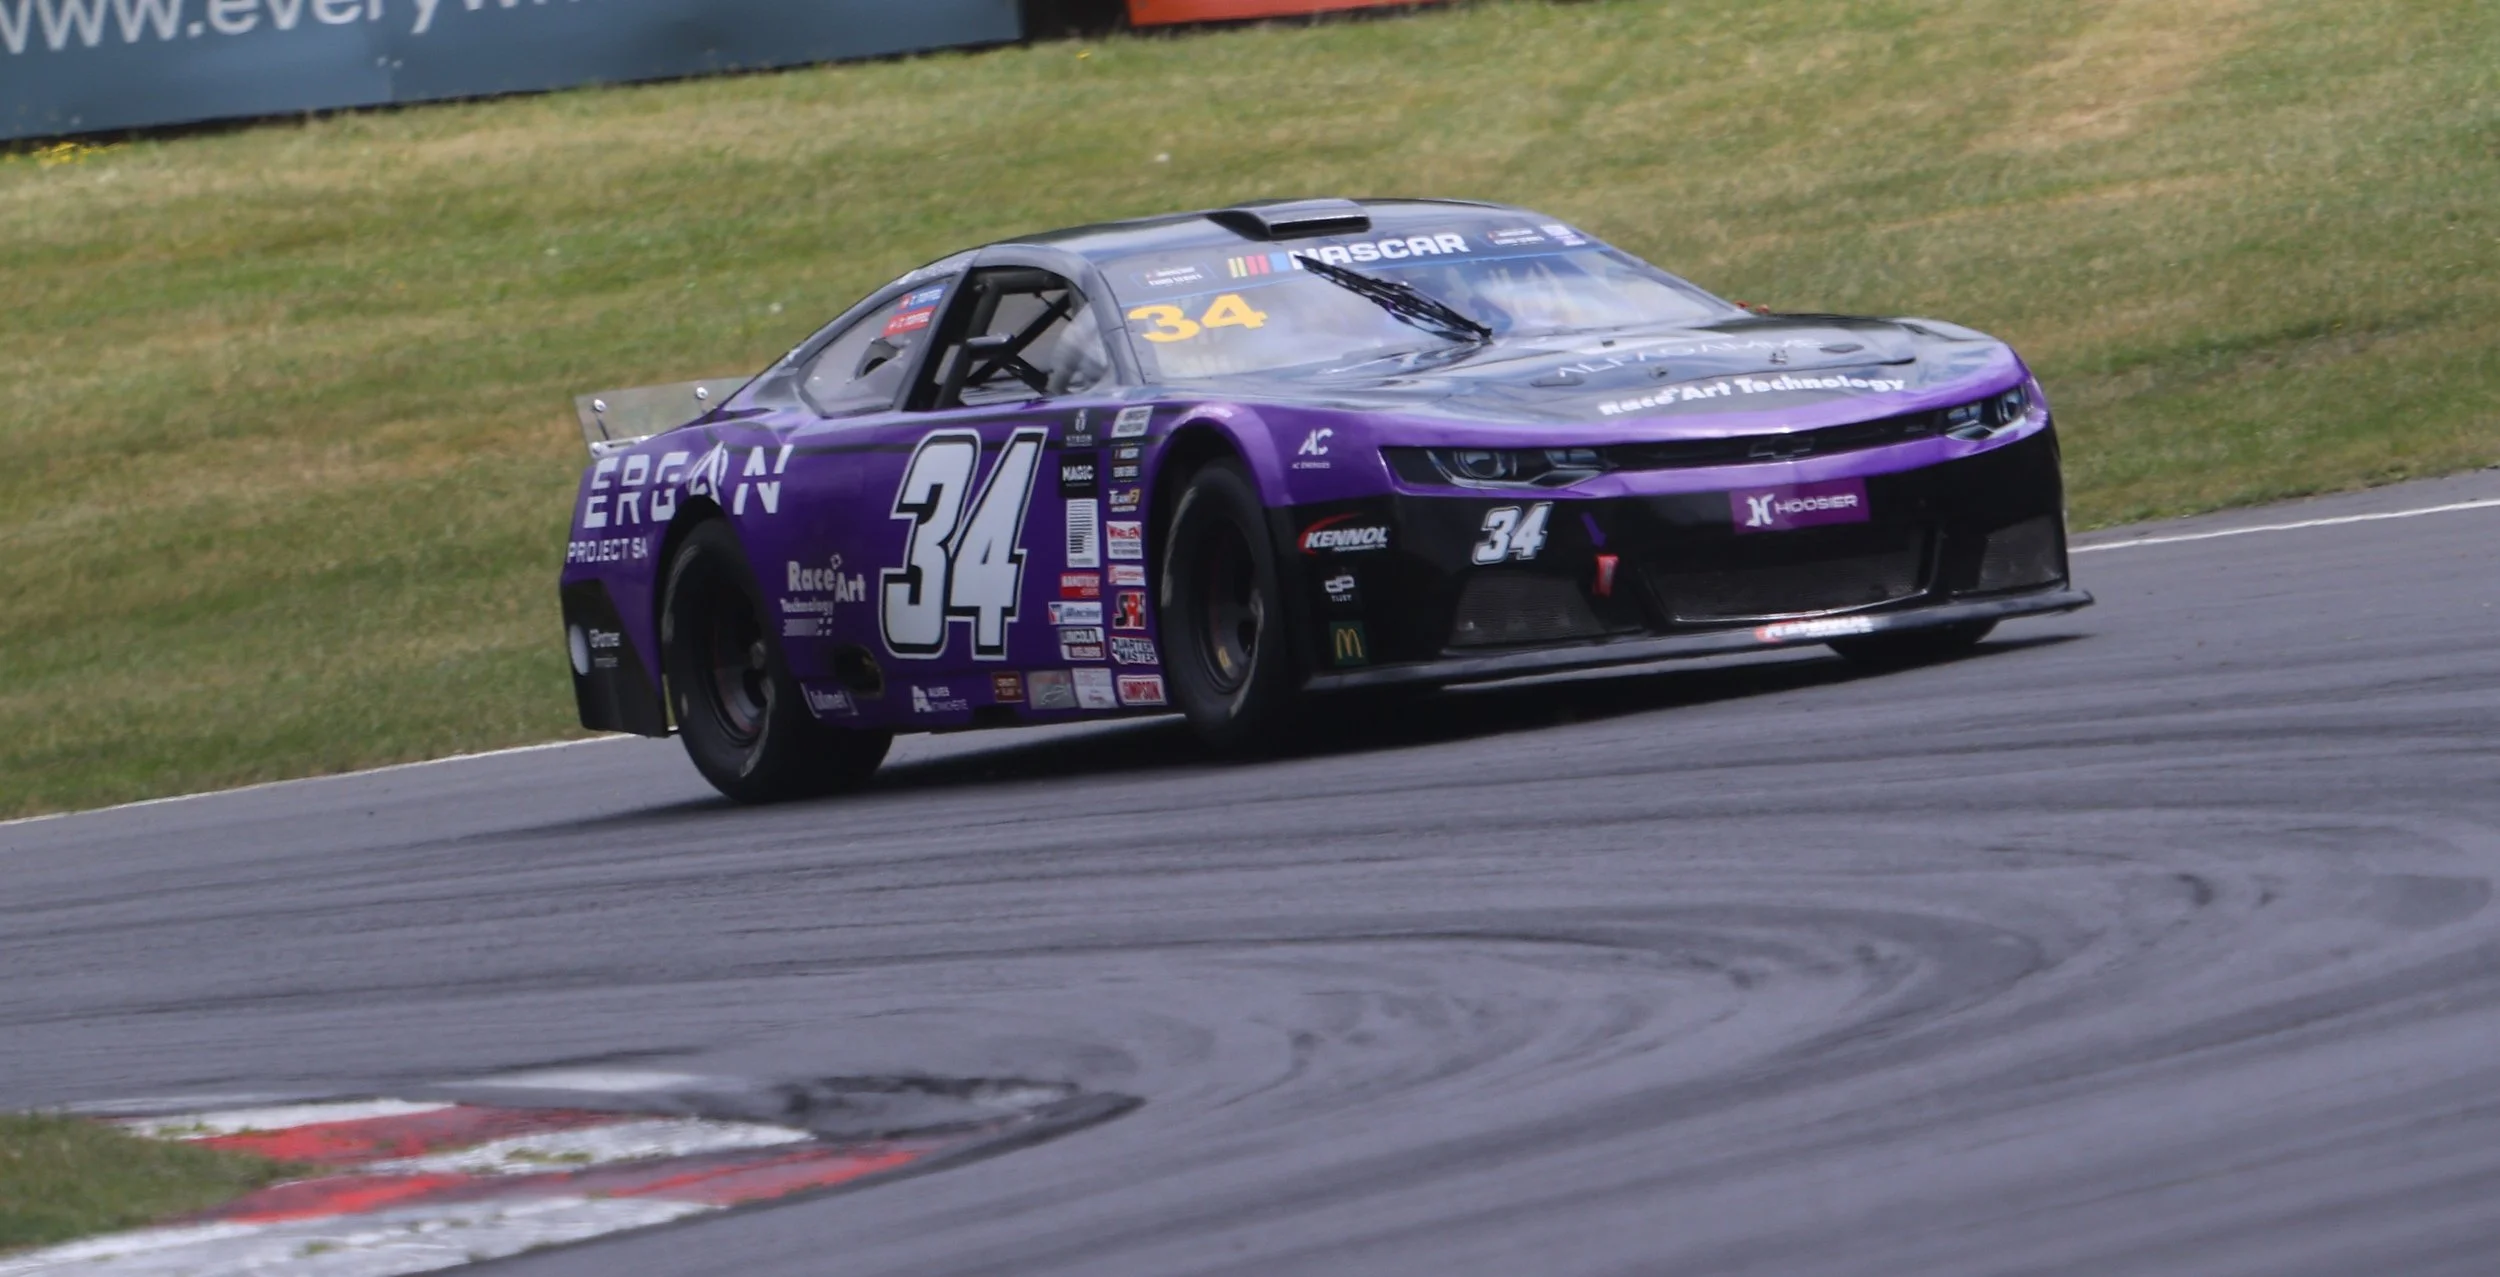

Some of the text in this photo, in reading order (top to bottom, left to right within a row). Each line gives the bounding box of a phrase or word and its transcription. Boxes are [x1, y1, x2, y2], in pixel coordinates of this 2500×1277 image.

[1287, 232, 1471, 270] NASCAR
[1127, 293, 1268, 342] 34
[1680, 380, 1732, 401] Art
[1734, 374, 1906, 393] Technology
[1774, 495, 1858, 514] HOOSIER
[879, 427, 1049, 661] 34
[1305, 527, 1388, 549] KENNOL
[1472, 502, 1553, 565] 34
[566, 537, 648, 563] PROJECT SA
[787, 560, 866, 602] Race Art
[780, 597, 834, 616] Technology
